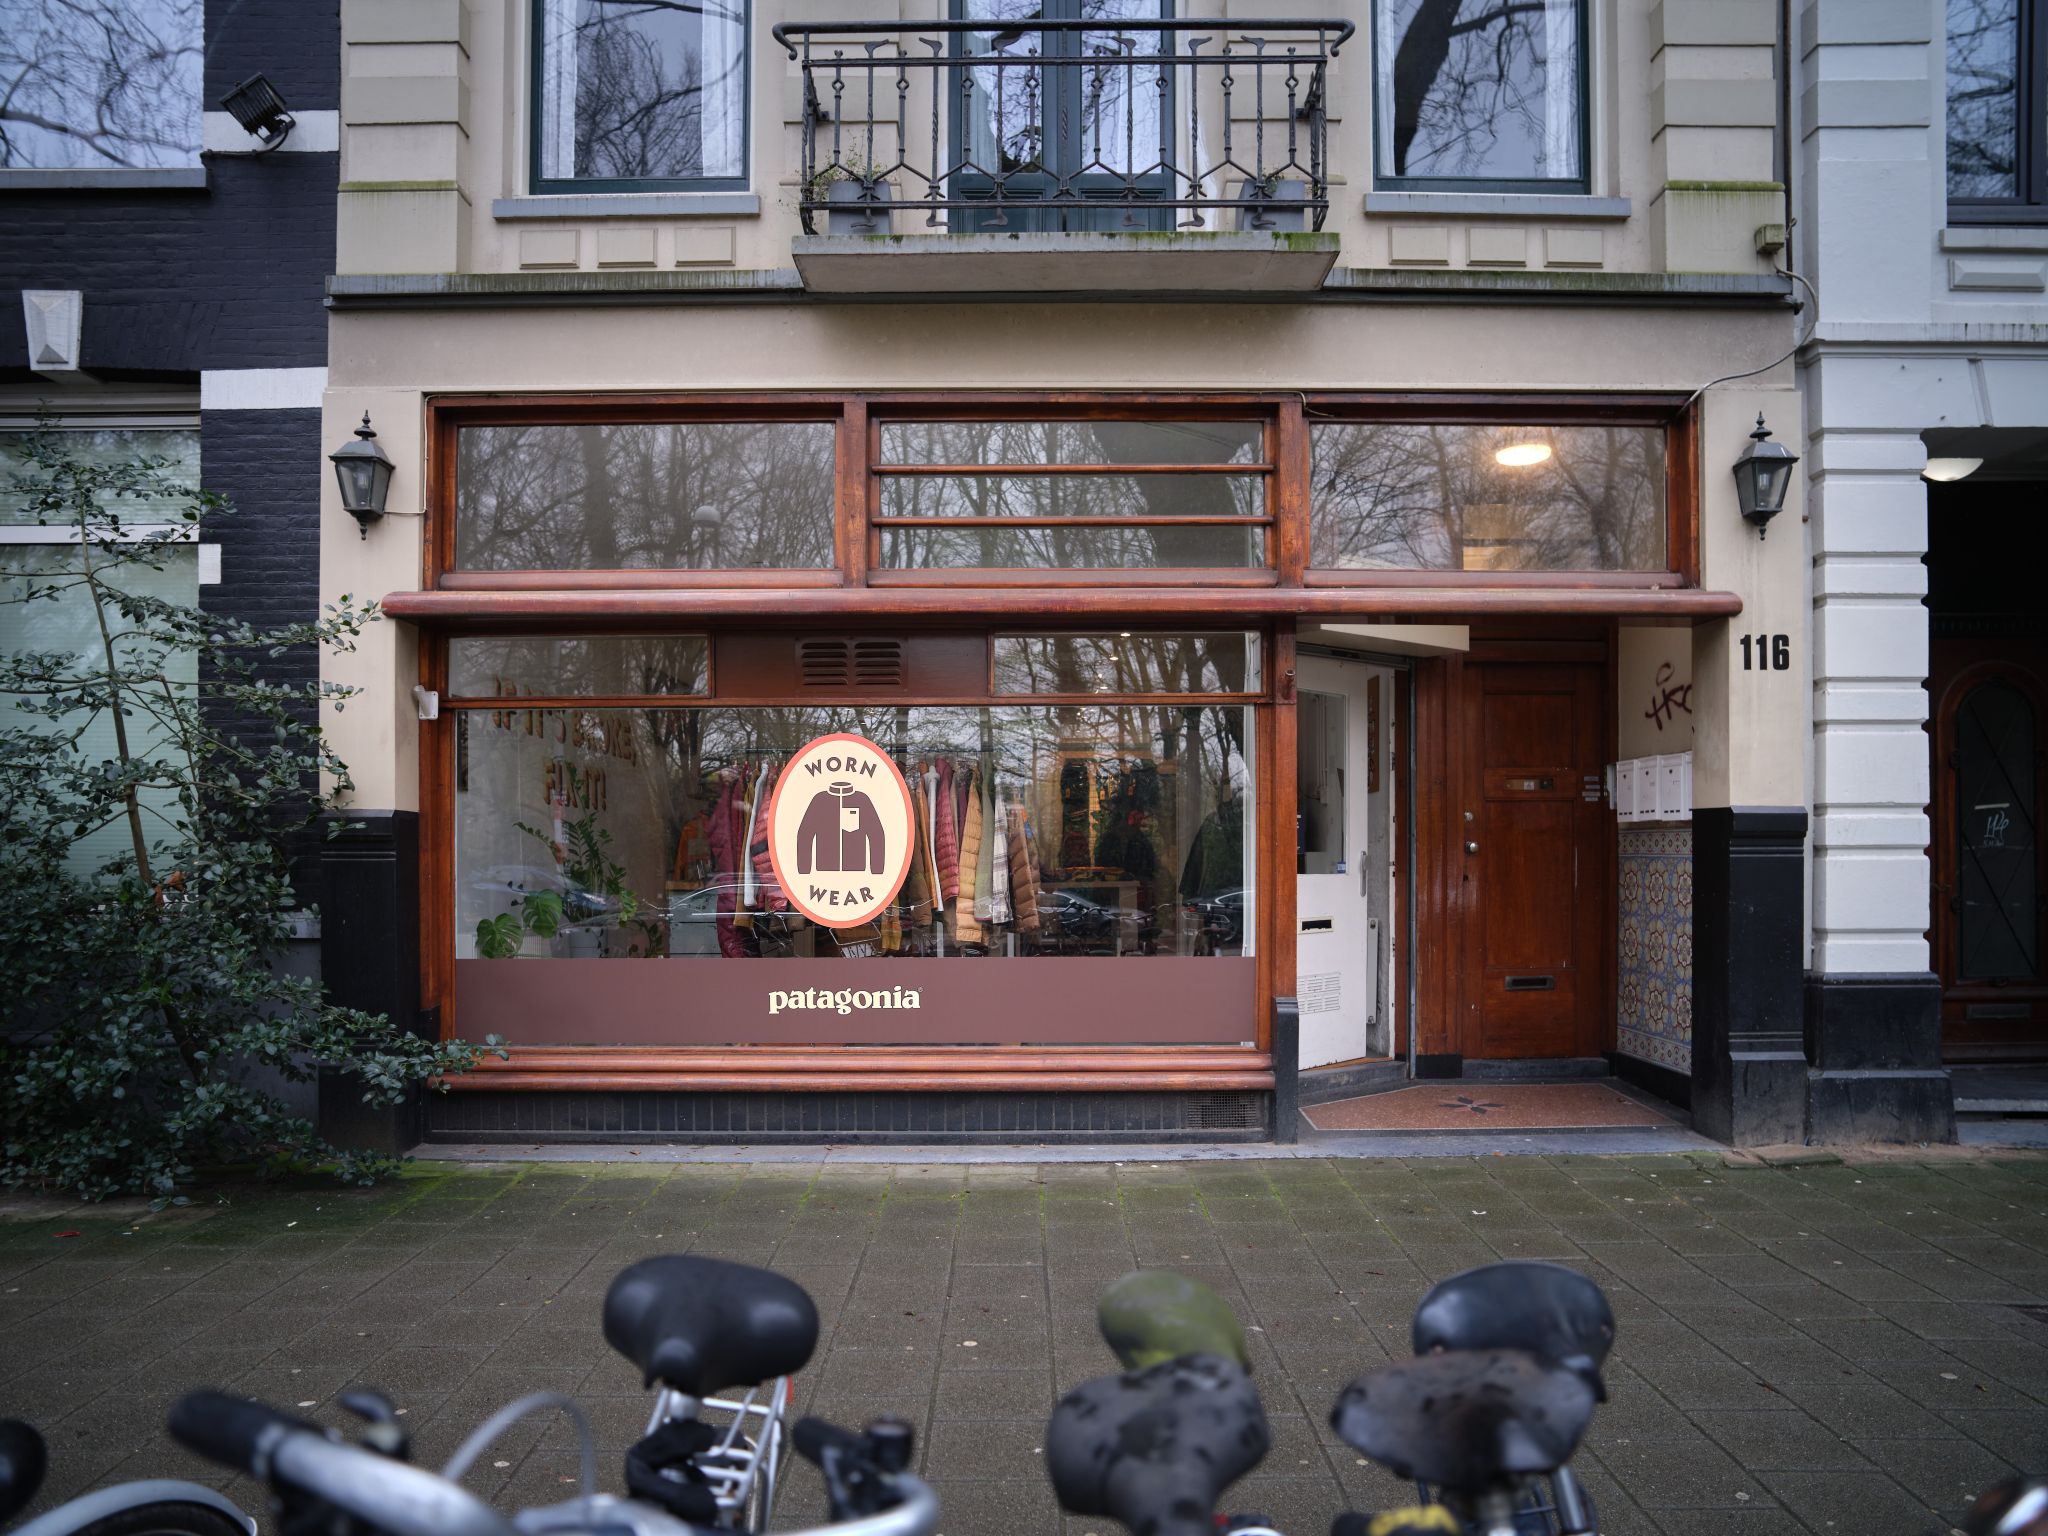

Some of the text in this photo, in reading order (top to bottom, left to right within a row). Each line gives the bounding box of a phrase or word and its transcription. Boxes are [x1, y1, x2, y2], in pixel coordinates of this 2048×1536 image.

[1739, 633, 1790, 671] 116
[491, 673, 517, 730] IF
[804, 756, 878, 778] WORN
[584, 764, 607, 811] IT!
[809, 884, 875, 906] WEAR
[768, 985, 921, 1015] patagonia
